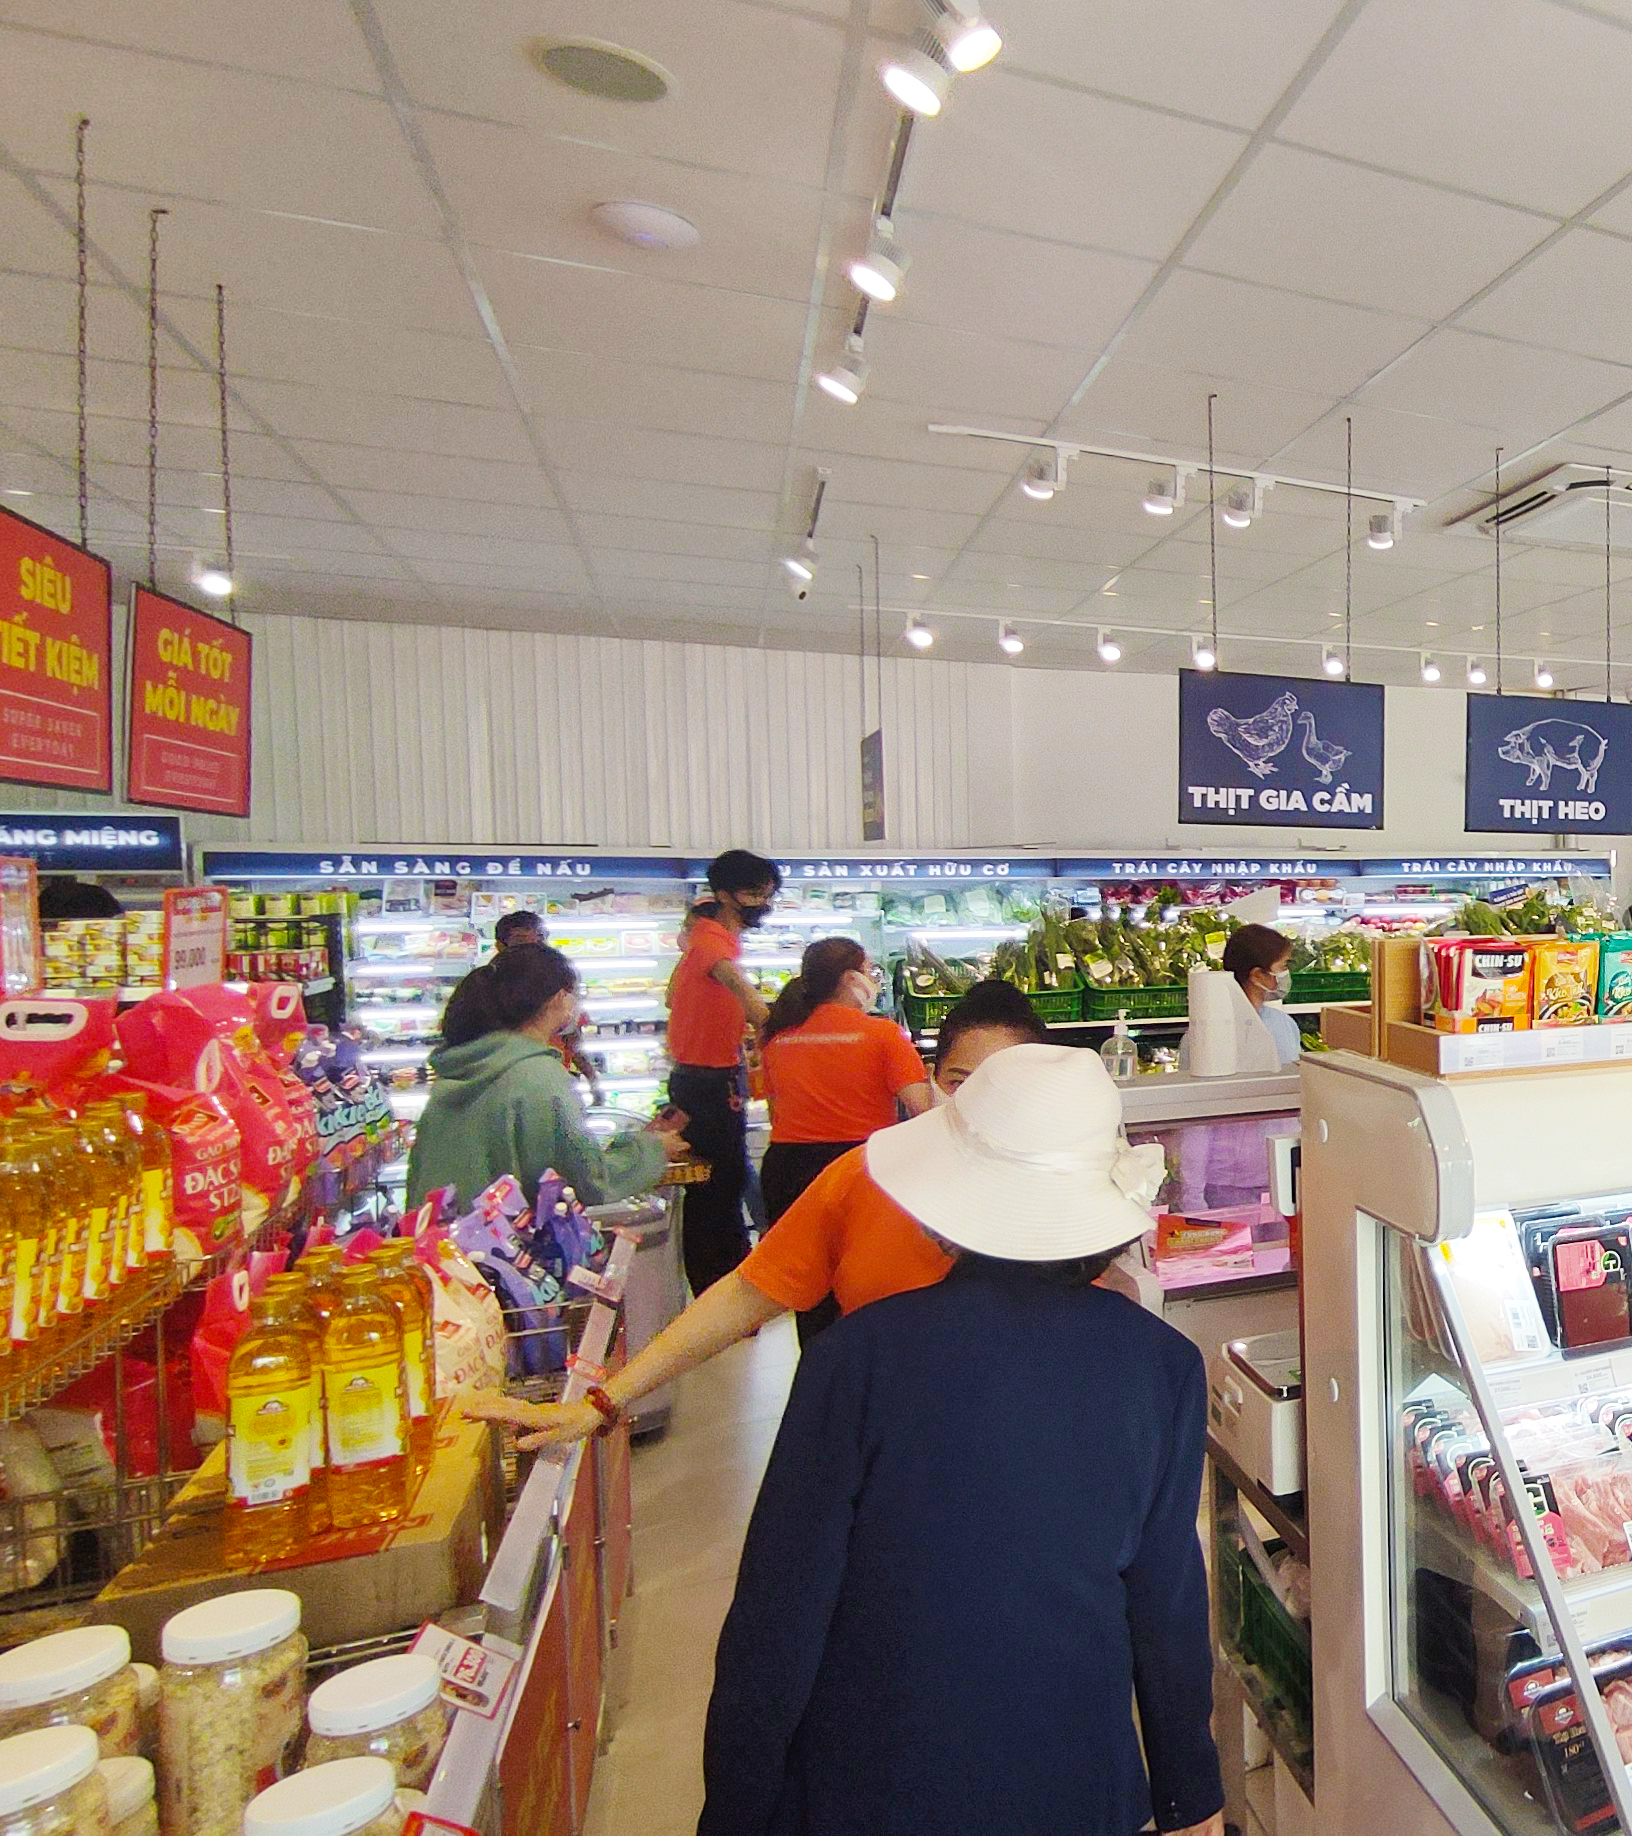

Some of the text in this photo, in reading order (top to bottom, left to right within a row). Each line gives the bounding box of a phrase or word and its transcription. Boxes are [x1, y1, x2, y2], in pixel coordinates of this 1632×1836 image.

[19, 555, 72, 615] SIÊU
[45, 634, 99, 695] KIỆM
[157, 627, 233, 683] GIÁ TỐT
[144, 669, 241, 737] MỖI NGÀY
[1188, 781, 1373, 816] THỊT GIA CẦM
[1499, 798, 1606, 825] THỊT HEO
[0, 826, 160, 849] ÁNG MIỆNG
[394, 857, 472, 875] SÀNG
[486, 858, 522, 875] ĐỂ
[536, 860, 591, 876] NẤU
[804, 861, 849, 877] SẢN
[859, 860, 918, 877] XUẤT
[928, 862, 972, 877] HỮU
[982, 862, 1010, 876] CƠ
[1112, 859, 1318, 877] TRÁI CÂY NHẬP KHẨU
[1402, 861, 1441, 873] TRÁI
[1447, 860, 1479, 873] CÂY
[1484, 860, 1526, 876] NHẬP
[1475, 954, 1523, 968] CHIN-SU
[1478, 1022, 1513, 1033] CHIN-SU
